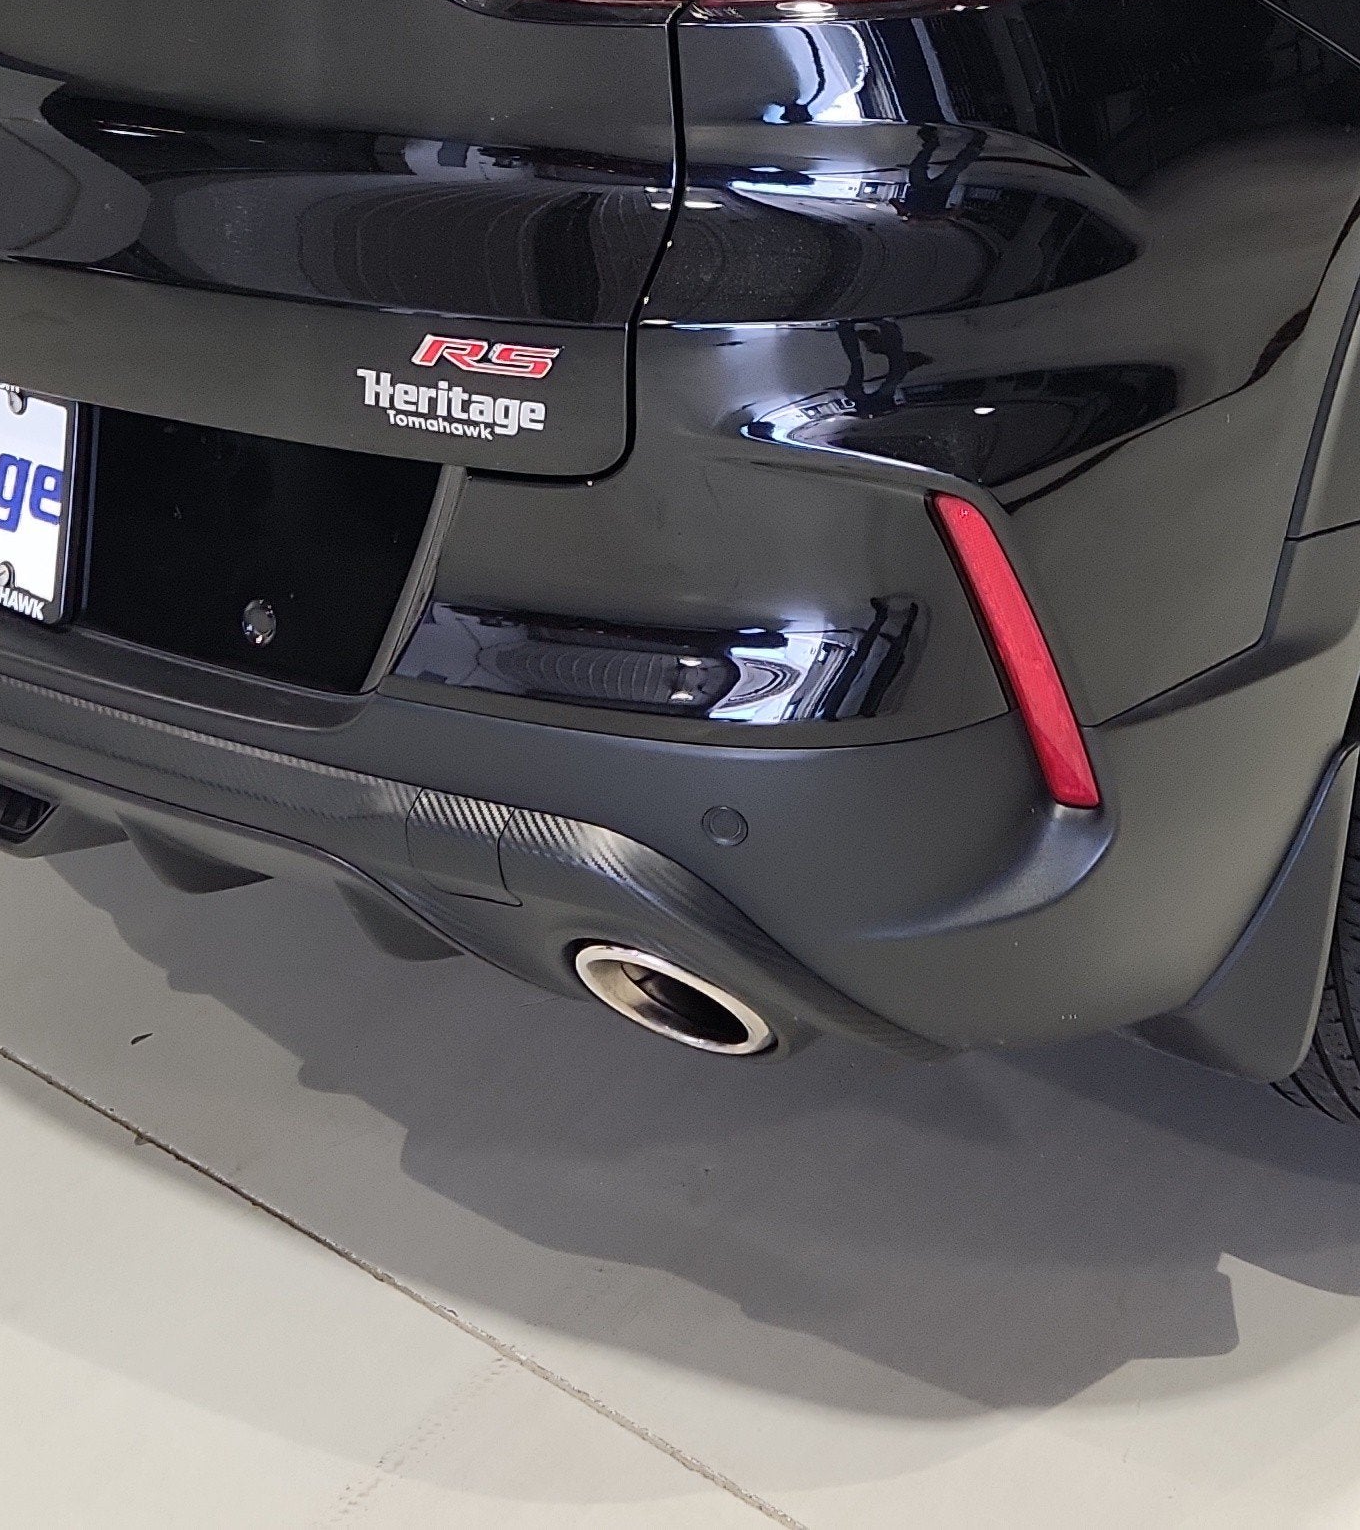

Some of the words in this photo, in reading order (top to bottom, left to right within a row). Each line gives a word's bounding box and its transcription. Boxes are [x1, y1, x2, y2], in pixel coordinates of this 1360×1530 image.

[411, 333, 561, 379] RS
[356, 368, 546, 436] Heritage
[386, 409, 493, 441] Tomahawk
